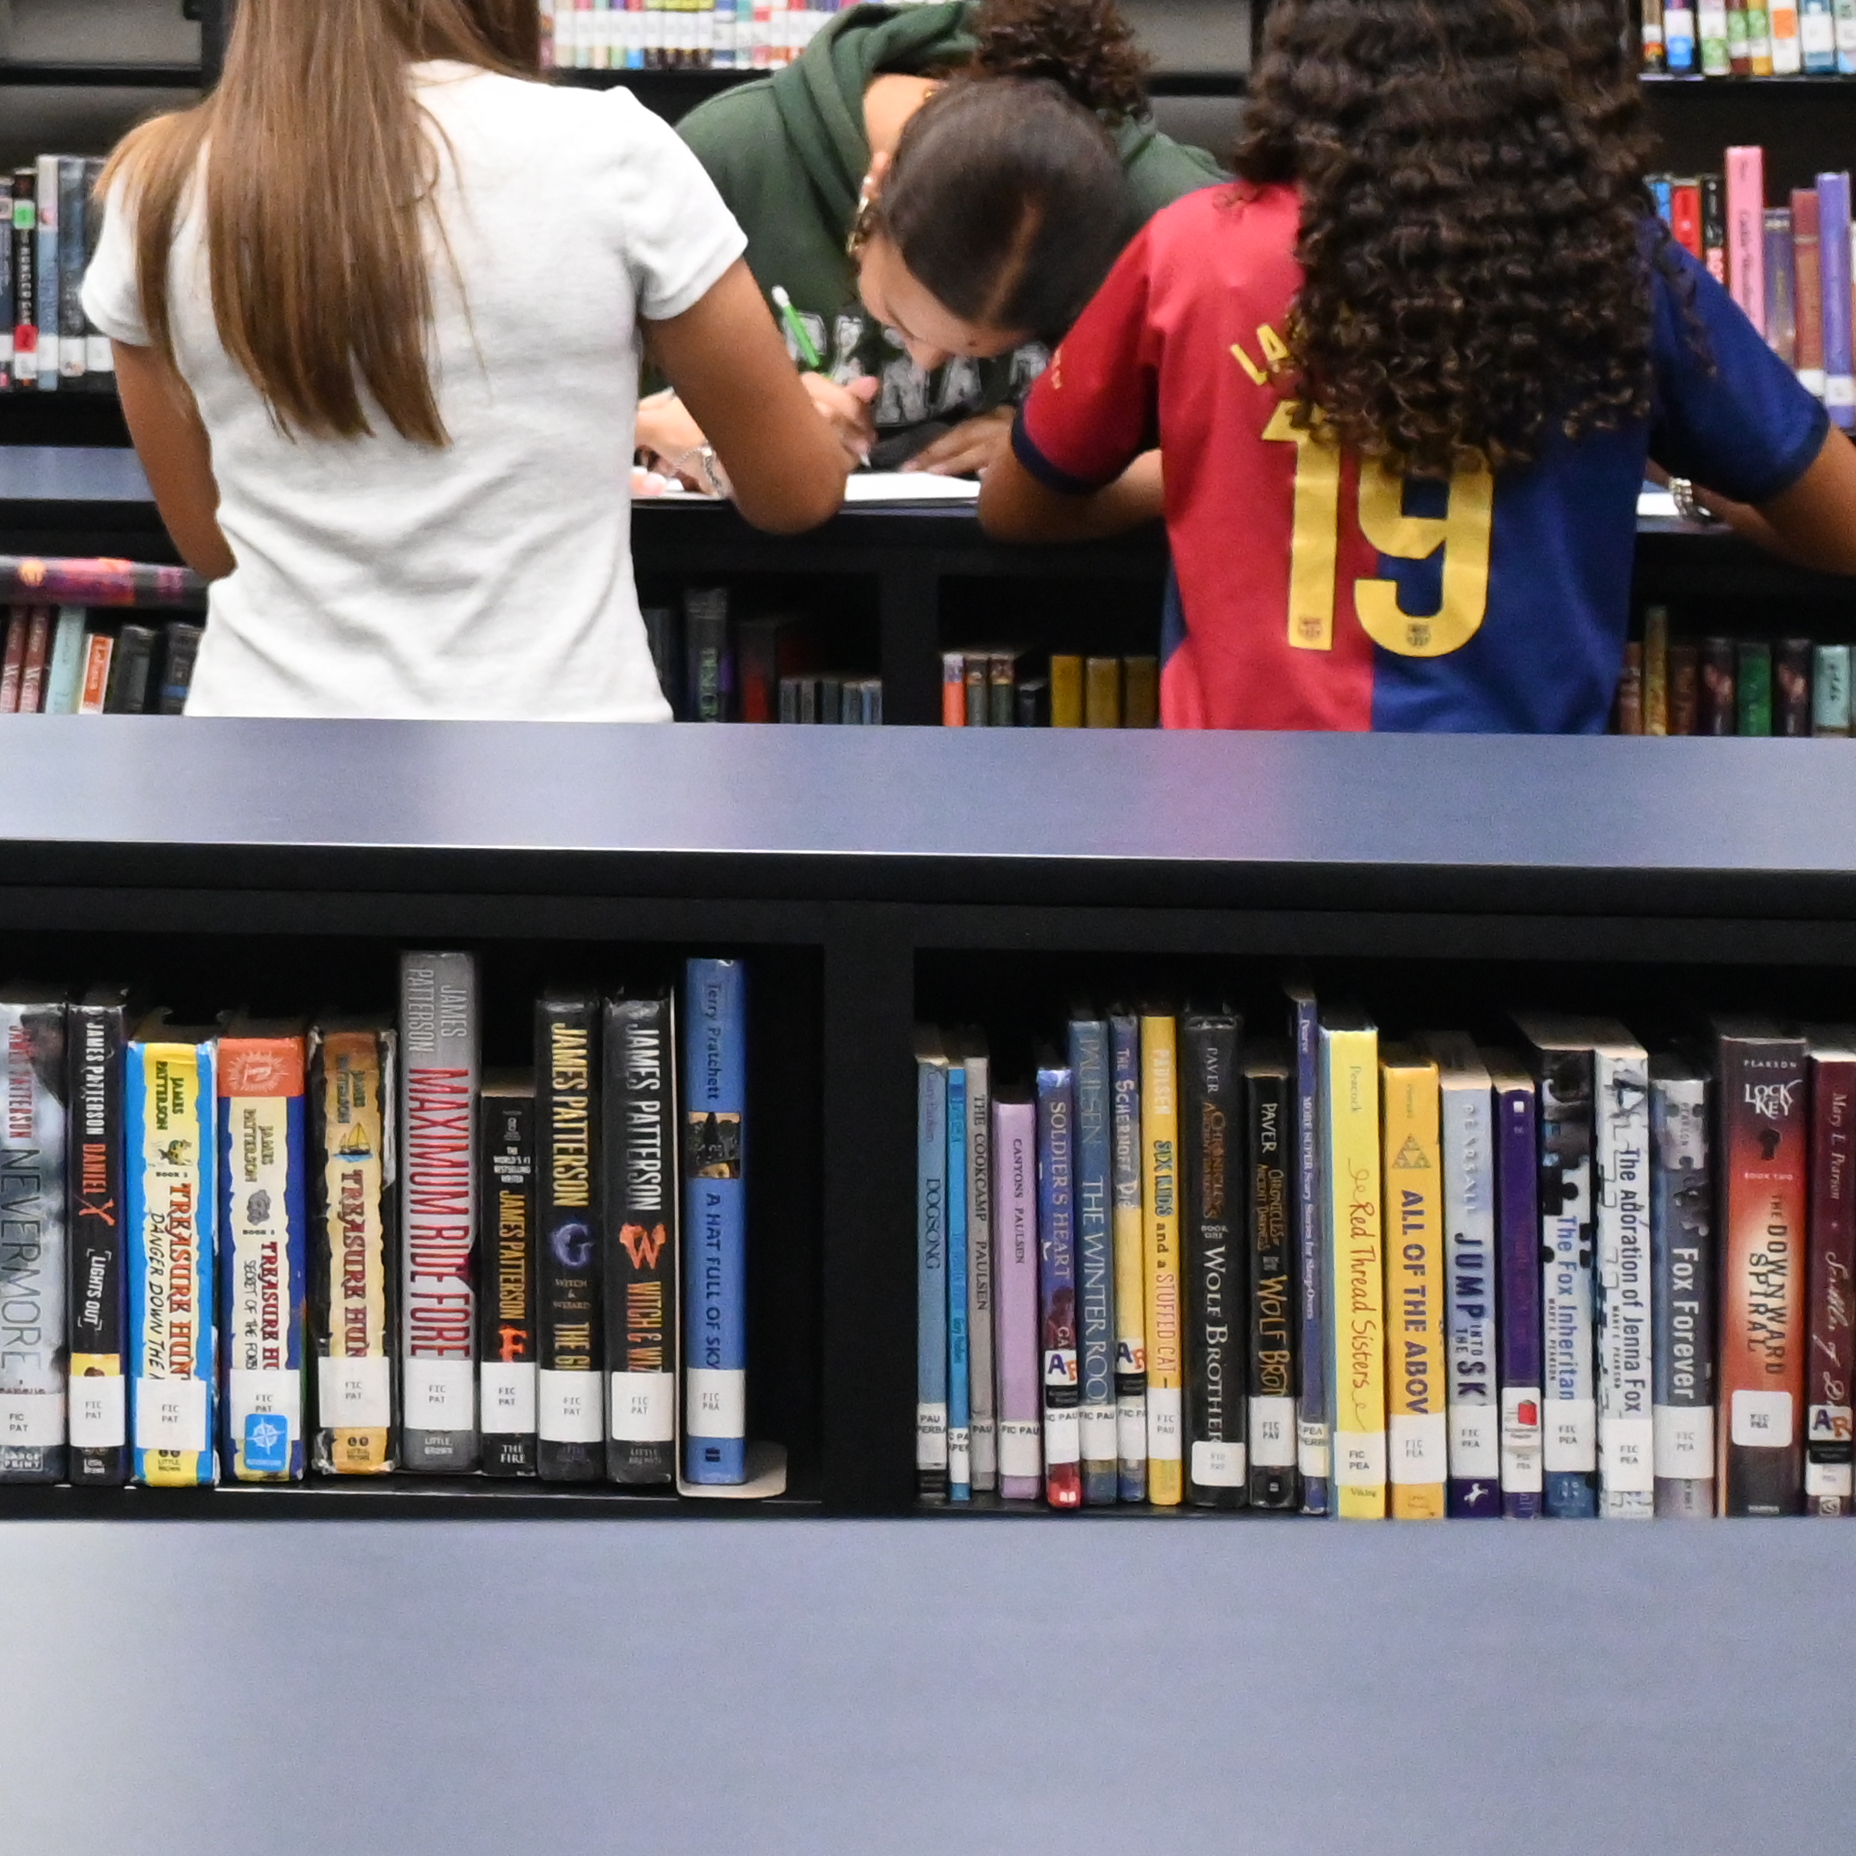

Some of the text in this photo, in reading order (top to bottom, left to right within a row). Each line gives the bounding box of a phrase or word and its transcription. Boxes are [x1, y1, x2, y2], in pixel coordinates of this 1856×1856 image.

[1262, 400, 1493, 657] 19
[407, 968, 435, 1052] PATTERSON
[440, 985, 467, 1038] JAMES
[706, 983, 724, 1100] Terry Pratchett
[1744, 1060, 1797, 1068] PEARSON
[85, 1022, 105, 1136] JAMES PATTERSON
[551, 1023, 589, 1207] JAMES PATTERSON
[625, 1024, 662, 1211] JAMES PATTERSON
[1079, 1035, 1102, 1144] PAULSEN
[1205, 1046, 1219, 1094] PAVER
[1260, 1102, 1278, 1154] PAVER
[408, 1068, 471, 1357] MAXIMUM RIDE FORE
[974, 1096, 988, 1222] THE COOKCAMP
[1012, 1138, 1025, 1264] CANYONS PAULSEN
[1050, 1102, 1070, 1279] SOLDIER'S HEART
[1153, 1140, 1174, 1254] SIX KIDS and
[0, 1148, 42, 1371] NEVERMORE
[168, 1183, 193, 1314] TREASURE
[499, 1190, 526, 1320] JAMES PATTERSON
[706, 1193, 721, 1370] A HAT FULL OF SKY
[924, 1179, 940, 1270] DOGSONG
[974, 1242, 989, 1311] PAULSEN
[1202, 1246, 1226, 1318] WOLF
[1454, 1233, 1484, 1324] JUMP
[1619, 1149, 1645, 1413] The Adoration of Jenna Fox
[146, 1212, 165, 1371] DANGER DOWN THE
[260, 1241, 280, 1341] TREASURE
[627, 1281, 662, 1328] WITCH
[1081, 1176, 1108, 1405] THE WINTER ROO
[1348, 1202, 1376, 1390] Red Thread Sisters
[1401, 1189, 1429, 1414] ALL OF THE ABOV
[1456, 1329, 1468, 1355] THE
[1471, 1324, 1484, 1358] INTO
[1556, 1215, 1578, 1400] The Fox Inheritan
[1672, 1247, 1699, 1399] Fox Forever
[1748, 1253, 1768, 1353] SPIRAL
[1766, 1224, 1788, 1374] DOWNWARD
[1204, 1323, 1228, 1442] BROTHER
[500, 1444, 524, 1454] THE
[500, 1453, 526, 1464] FIRE
[1620, 1456, 1638, 1464] PEA
